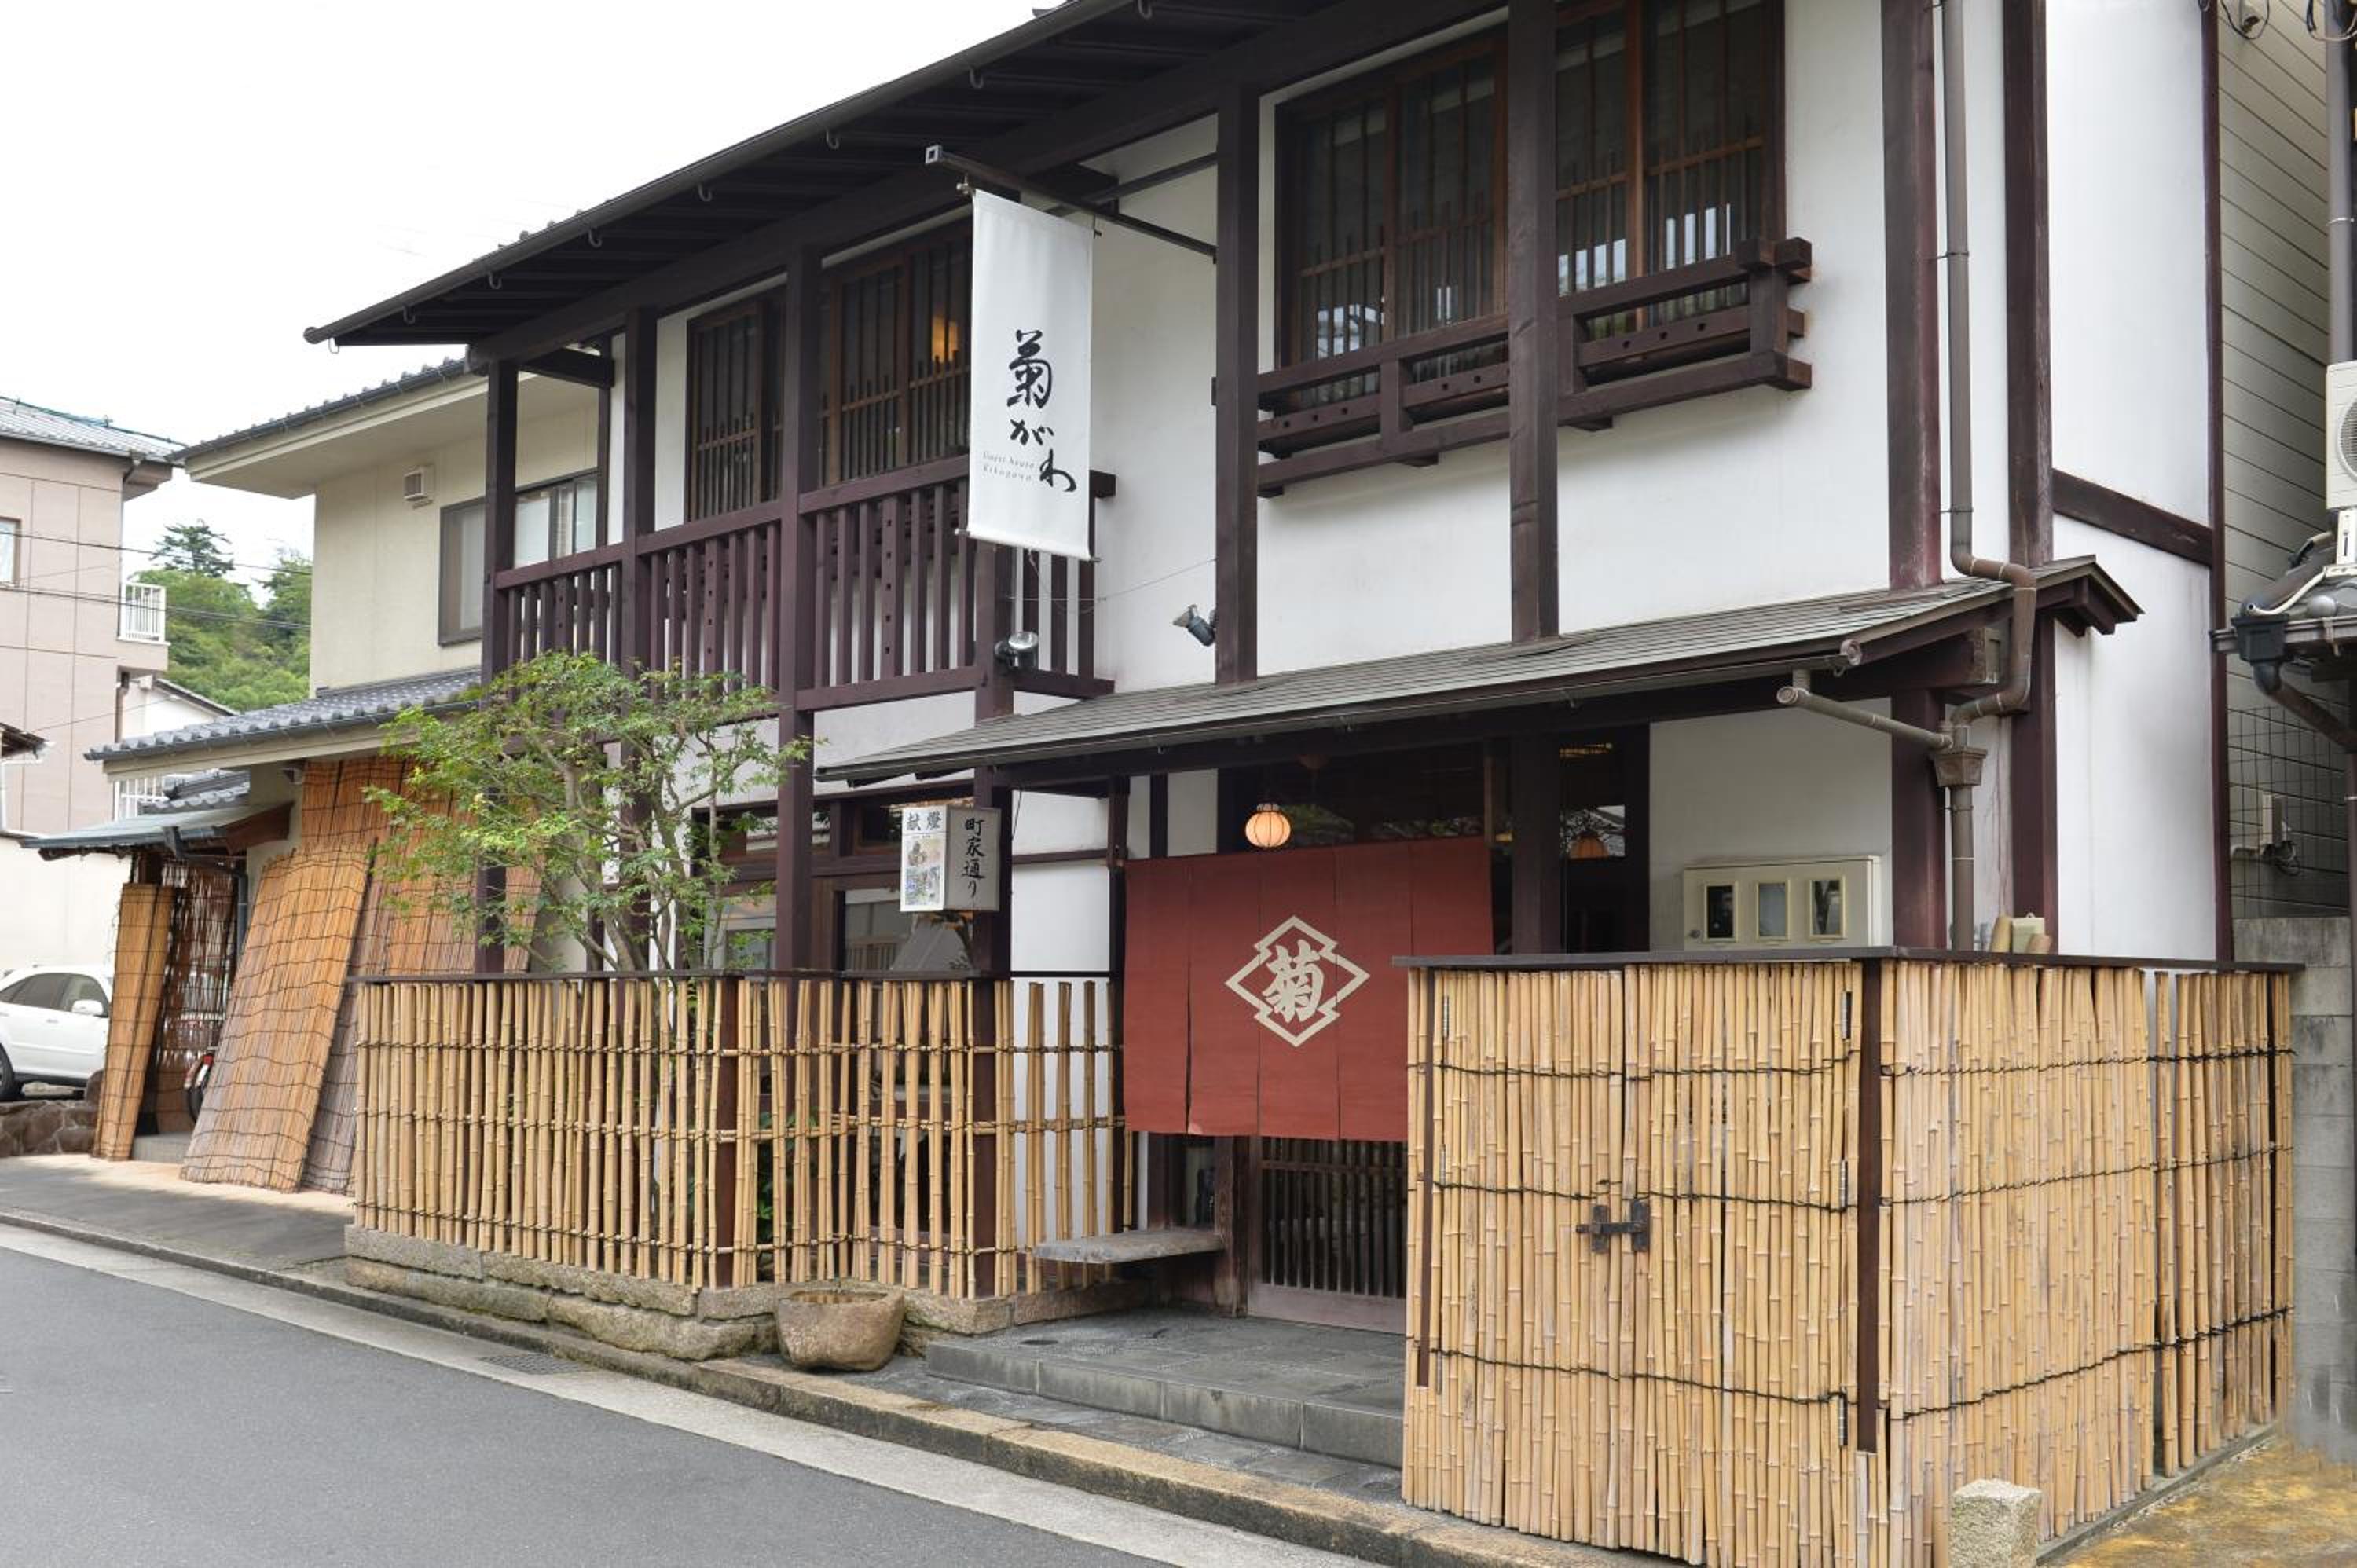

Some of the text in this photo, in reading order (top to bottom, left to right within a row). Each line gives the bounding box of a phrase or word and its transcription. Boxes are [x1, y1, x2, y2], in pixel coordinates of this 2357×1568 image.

[1006, 329, 1077, 493] 菊がわ
[962, 818, 987, 898] 町家通り
[1262, 939, 1325, 1023] 菊
